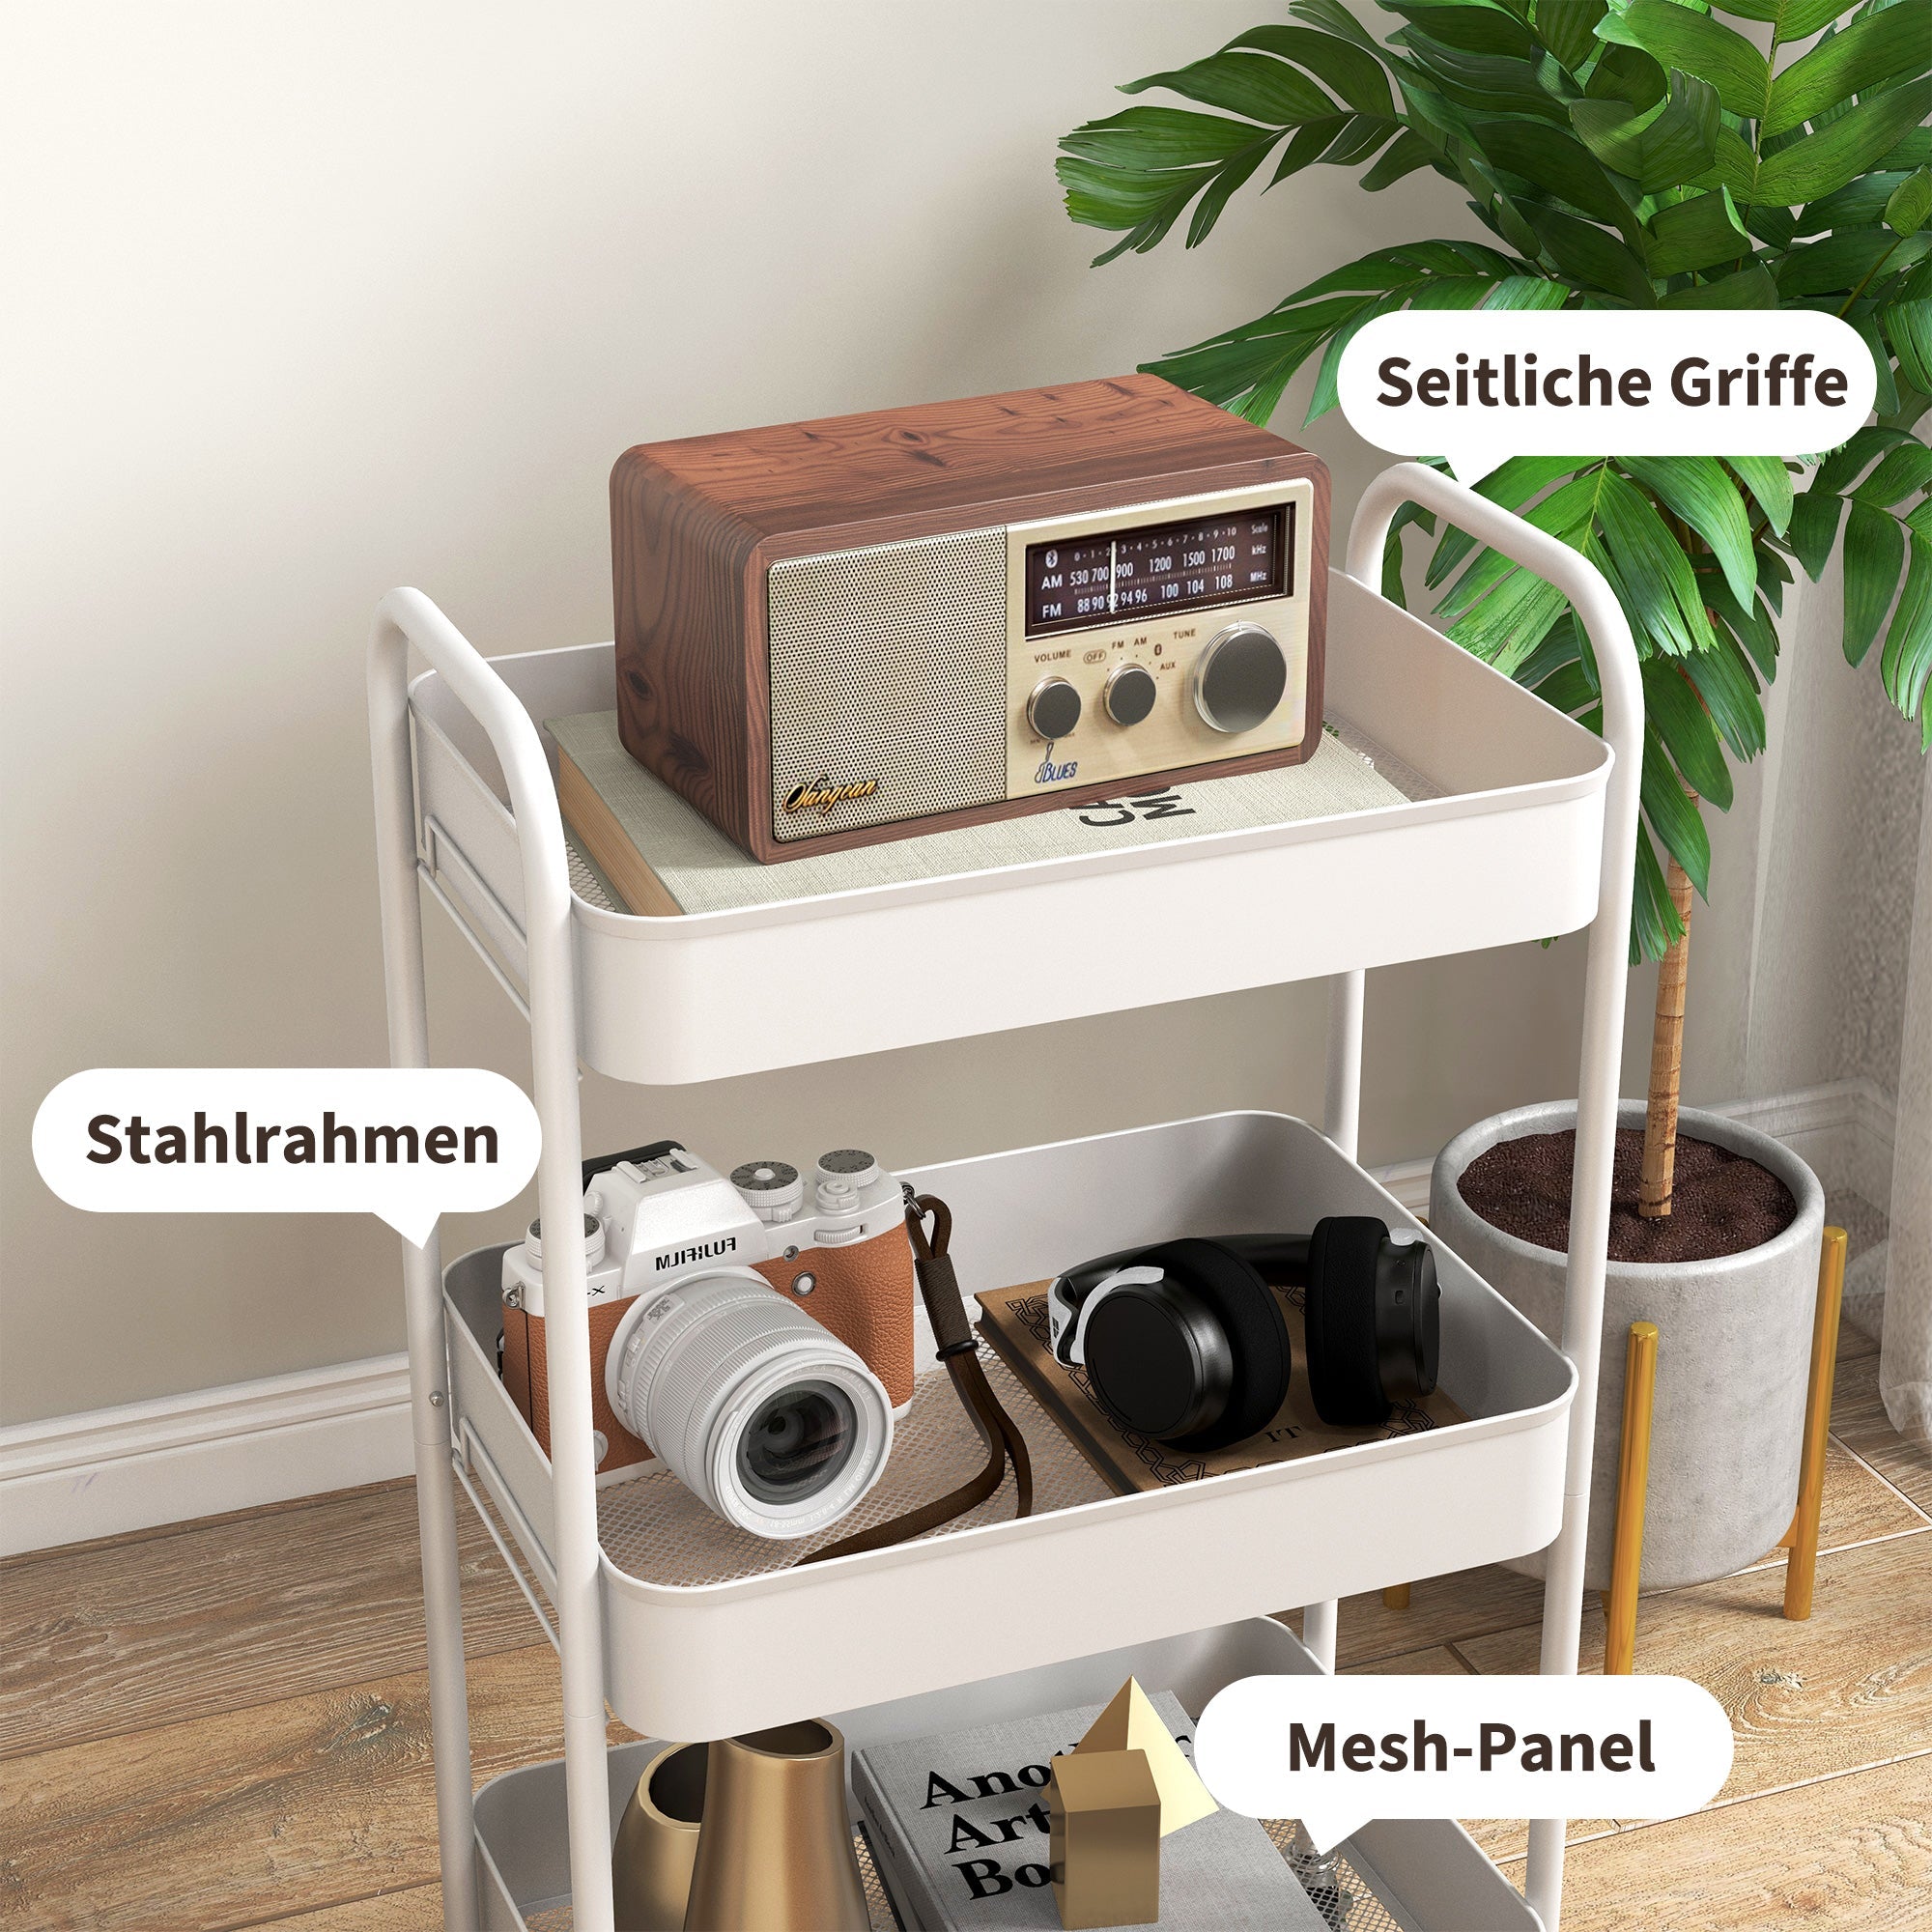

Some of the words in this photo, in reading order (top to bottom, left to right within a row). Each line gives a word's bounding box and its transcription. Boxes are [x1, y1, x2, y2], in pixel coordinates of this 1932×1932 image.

[1121, 544, 1126, 554] 3
[1137, 542, 1142, 552] 4
[1152, 539, 1157, 549] 5
[1167, 537, 1173, 547] 6
[1183, 534, 1188, 544] 7
[1198, 531, 1204, 541] 8
[1213, 529, 1219, 539] 9
[1227, 526, 1236, 537] 10
[1041, 574, 1063, 590] AM
[1069, 569, 1089, 586] 530
[1092, 566, 1109, 582] 700
[1116, 562, 1133, 579] 900
[1149, 555, 1172, 573] 1200
[1182, 551, 1206, 567] 1500
[1211, 546, 1236, 562] 1700
[1251, 544, 1266, 555] kHz
[1042, 603, 1062, 618] FM
[1077, 598, 1090, 613] 88
[1092, 595, 1105, 611] 90
[1121, 590, 1133, 606] 94
[1135, 588, 1148, 604] 96
[1161, 582, 1179, 599] 100
[1186, 579, 1204, 595] 104
[1215, 574, 1233, 590] 108
[1250, 570, 1266, 582] MHz
[1133, 637, 1148, 646] AM
[1174, 628, 1196, 639] TUNE
[1111, 640, 1124, 649] FM
[1034, 649, 1072, 664] VOLUME
[1087, 651, 1103, 662] OFF
[1159, 661, 1177, 670] AUX
[1042, 761, 1078, 782] BLUES
[1264, 1425, 1302, 1442] IT
[952, 1858, 1052, 1900] Bo
